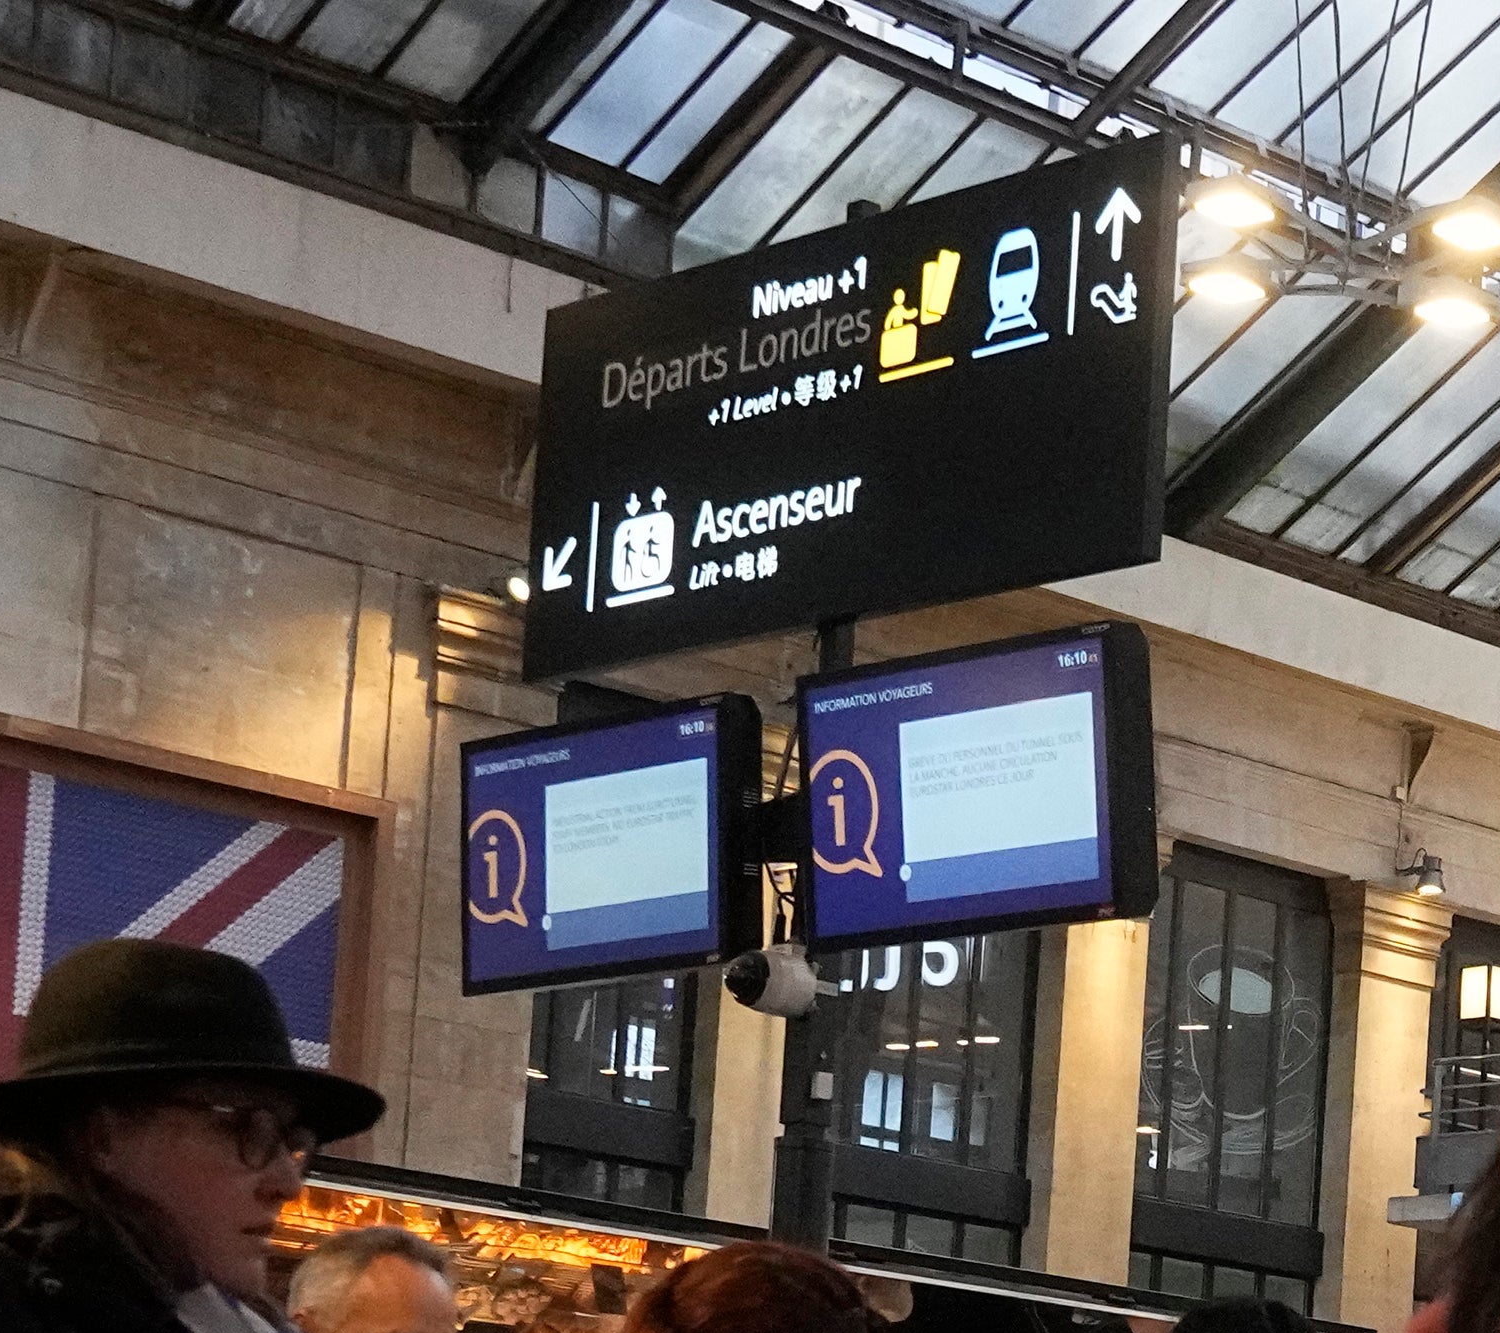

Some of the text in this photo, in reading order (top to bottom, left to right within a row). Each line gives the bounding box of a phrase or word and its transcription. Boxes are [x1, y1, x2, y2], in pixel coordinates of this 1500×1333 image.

[752, 255, 868, 319] Niveau +1
[601, 308, 873, 411] Départs Londres
[708, 398, 731, 427] +1
[731, 386, 780, 421] Level
[839, 364, 864, 394] +1
[691, 476, 863, 549] Ascenseur
[689, 560, 721, 591] Lift
[1057, 649, 1088, 669] 16:10
[813, 681, 934, 714] INFORMATION VOYAGEURS
